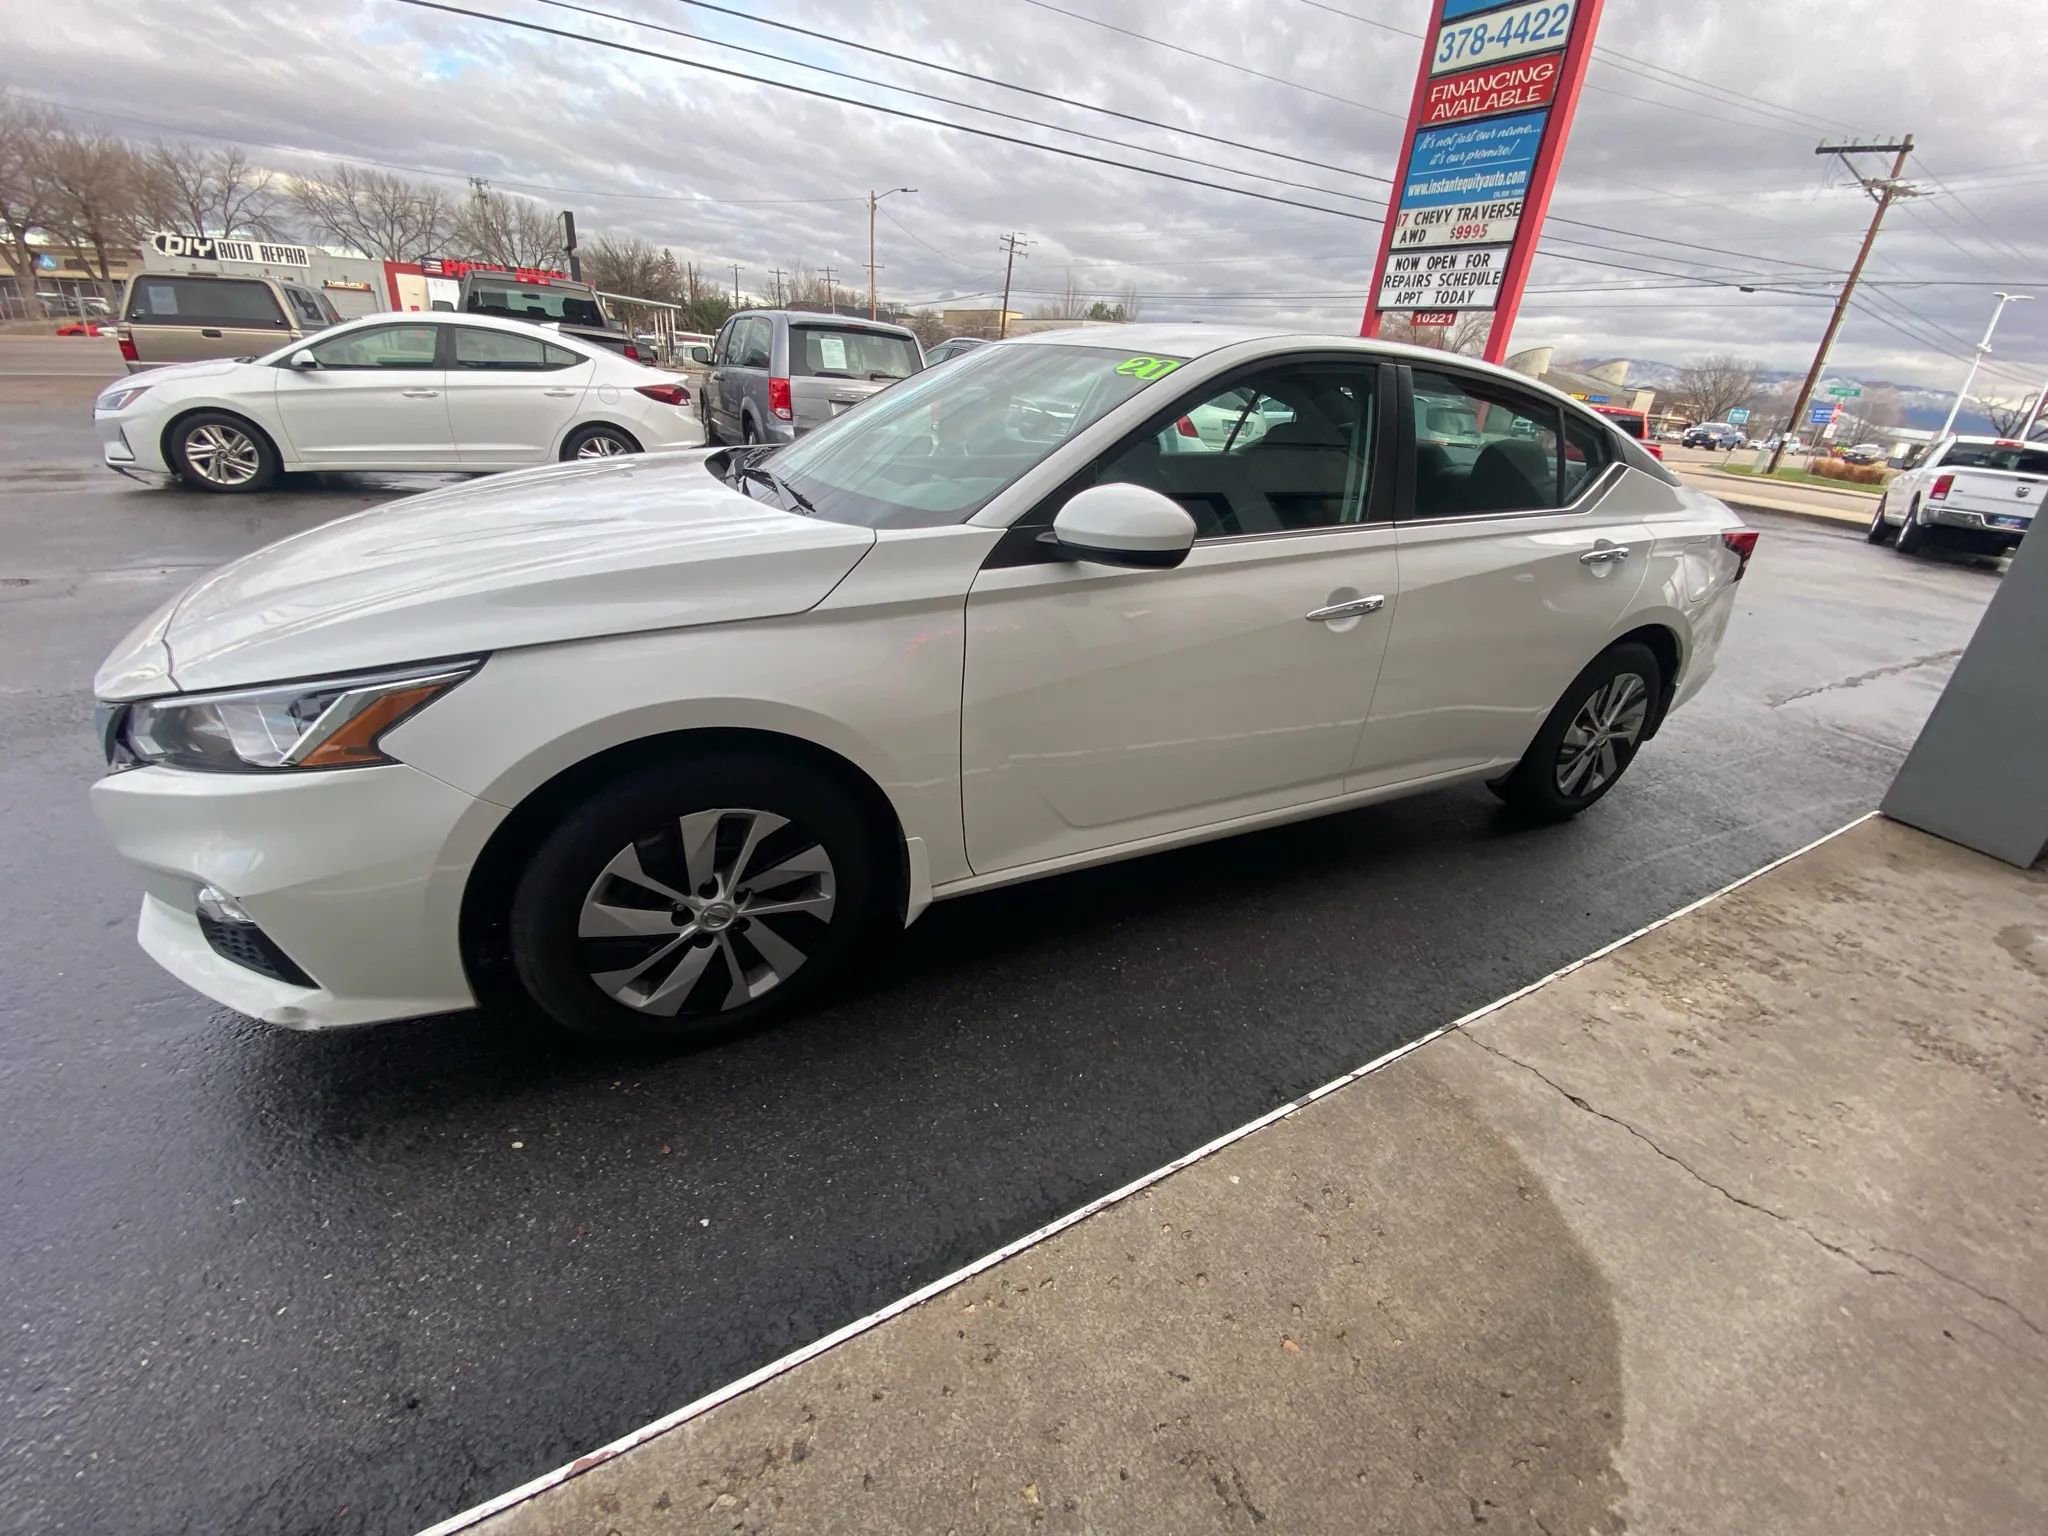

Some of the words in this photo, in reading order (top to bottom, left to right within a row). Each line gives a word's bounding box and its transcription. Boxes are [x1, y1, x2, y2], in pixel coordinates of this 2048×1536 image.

[1439, 4, 1569, 63] 378-4422
[1431, 63, 1554, 102] FINANCING
[1431, 85, 1544, 120] AVAILABLE
[1436, 133, 1455, 148] not
[1449, 130, 1475, 150] just
[1476, 129, 1495, 142] our
[1447, 150, 1465, 163] our
[1464, 139, 1520, 166] promise!
[1407, 169, 1527, 197] www.instantequityauto.com
[1414, 208, 1453, 225] CHEVY
[1456, 202, 1522, 222] TRAVERSE
[1400, 229, 1426, 244] AWD
[1450, 223, 1489, 240] $9995
[166, 236, 212, 257] DIY
[218, 242, 253, 260] AUTO
[260, 244, 308, 265] REPAIR
[1395, 257, 1420, 271] NOW
[1427, 254, 1456, 270] OPEN
[1465, 253, 1491, 268] FOR
[1384, 273, 1432, 288] REPAIRS
[1438, 271, 1501, 287] SCHEDULE
[1395, 291, 1422, 305] APPT
[1435, 290, 1474, 304] TODAY
[1415, 313, 1454, 324] 10221
[1117, 358, 1174, 378] 21
